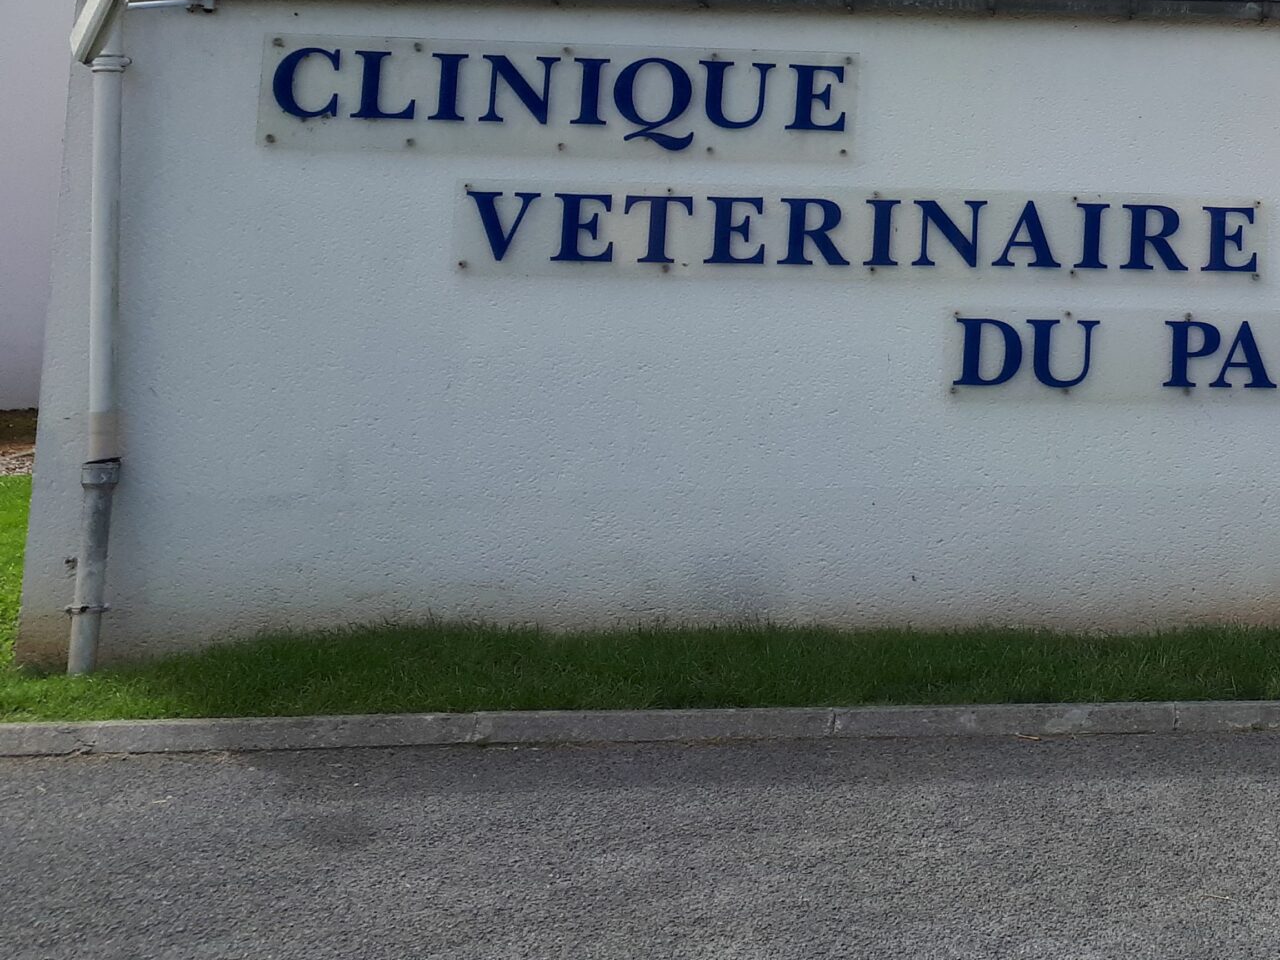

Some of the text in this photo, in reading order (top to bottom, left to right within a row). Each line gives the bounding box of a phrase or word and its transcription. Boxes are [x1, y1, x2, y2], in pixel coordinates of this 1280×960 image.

[271, 46, 846, 151] CLINIQUE
[466, 190, 1258, 273] VETERINAIRE
[953, 318, 1100, 389] DU
